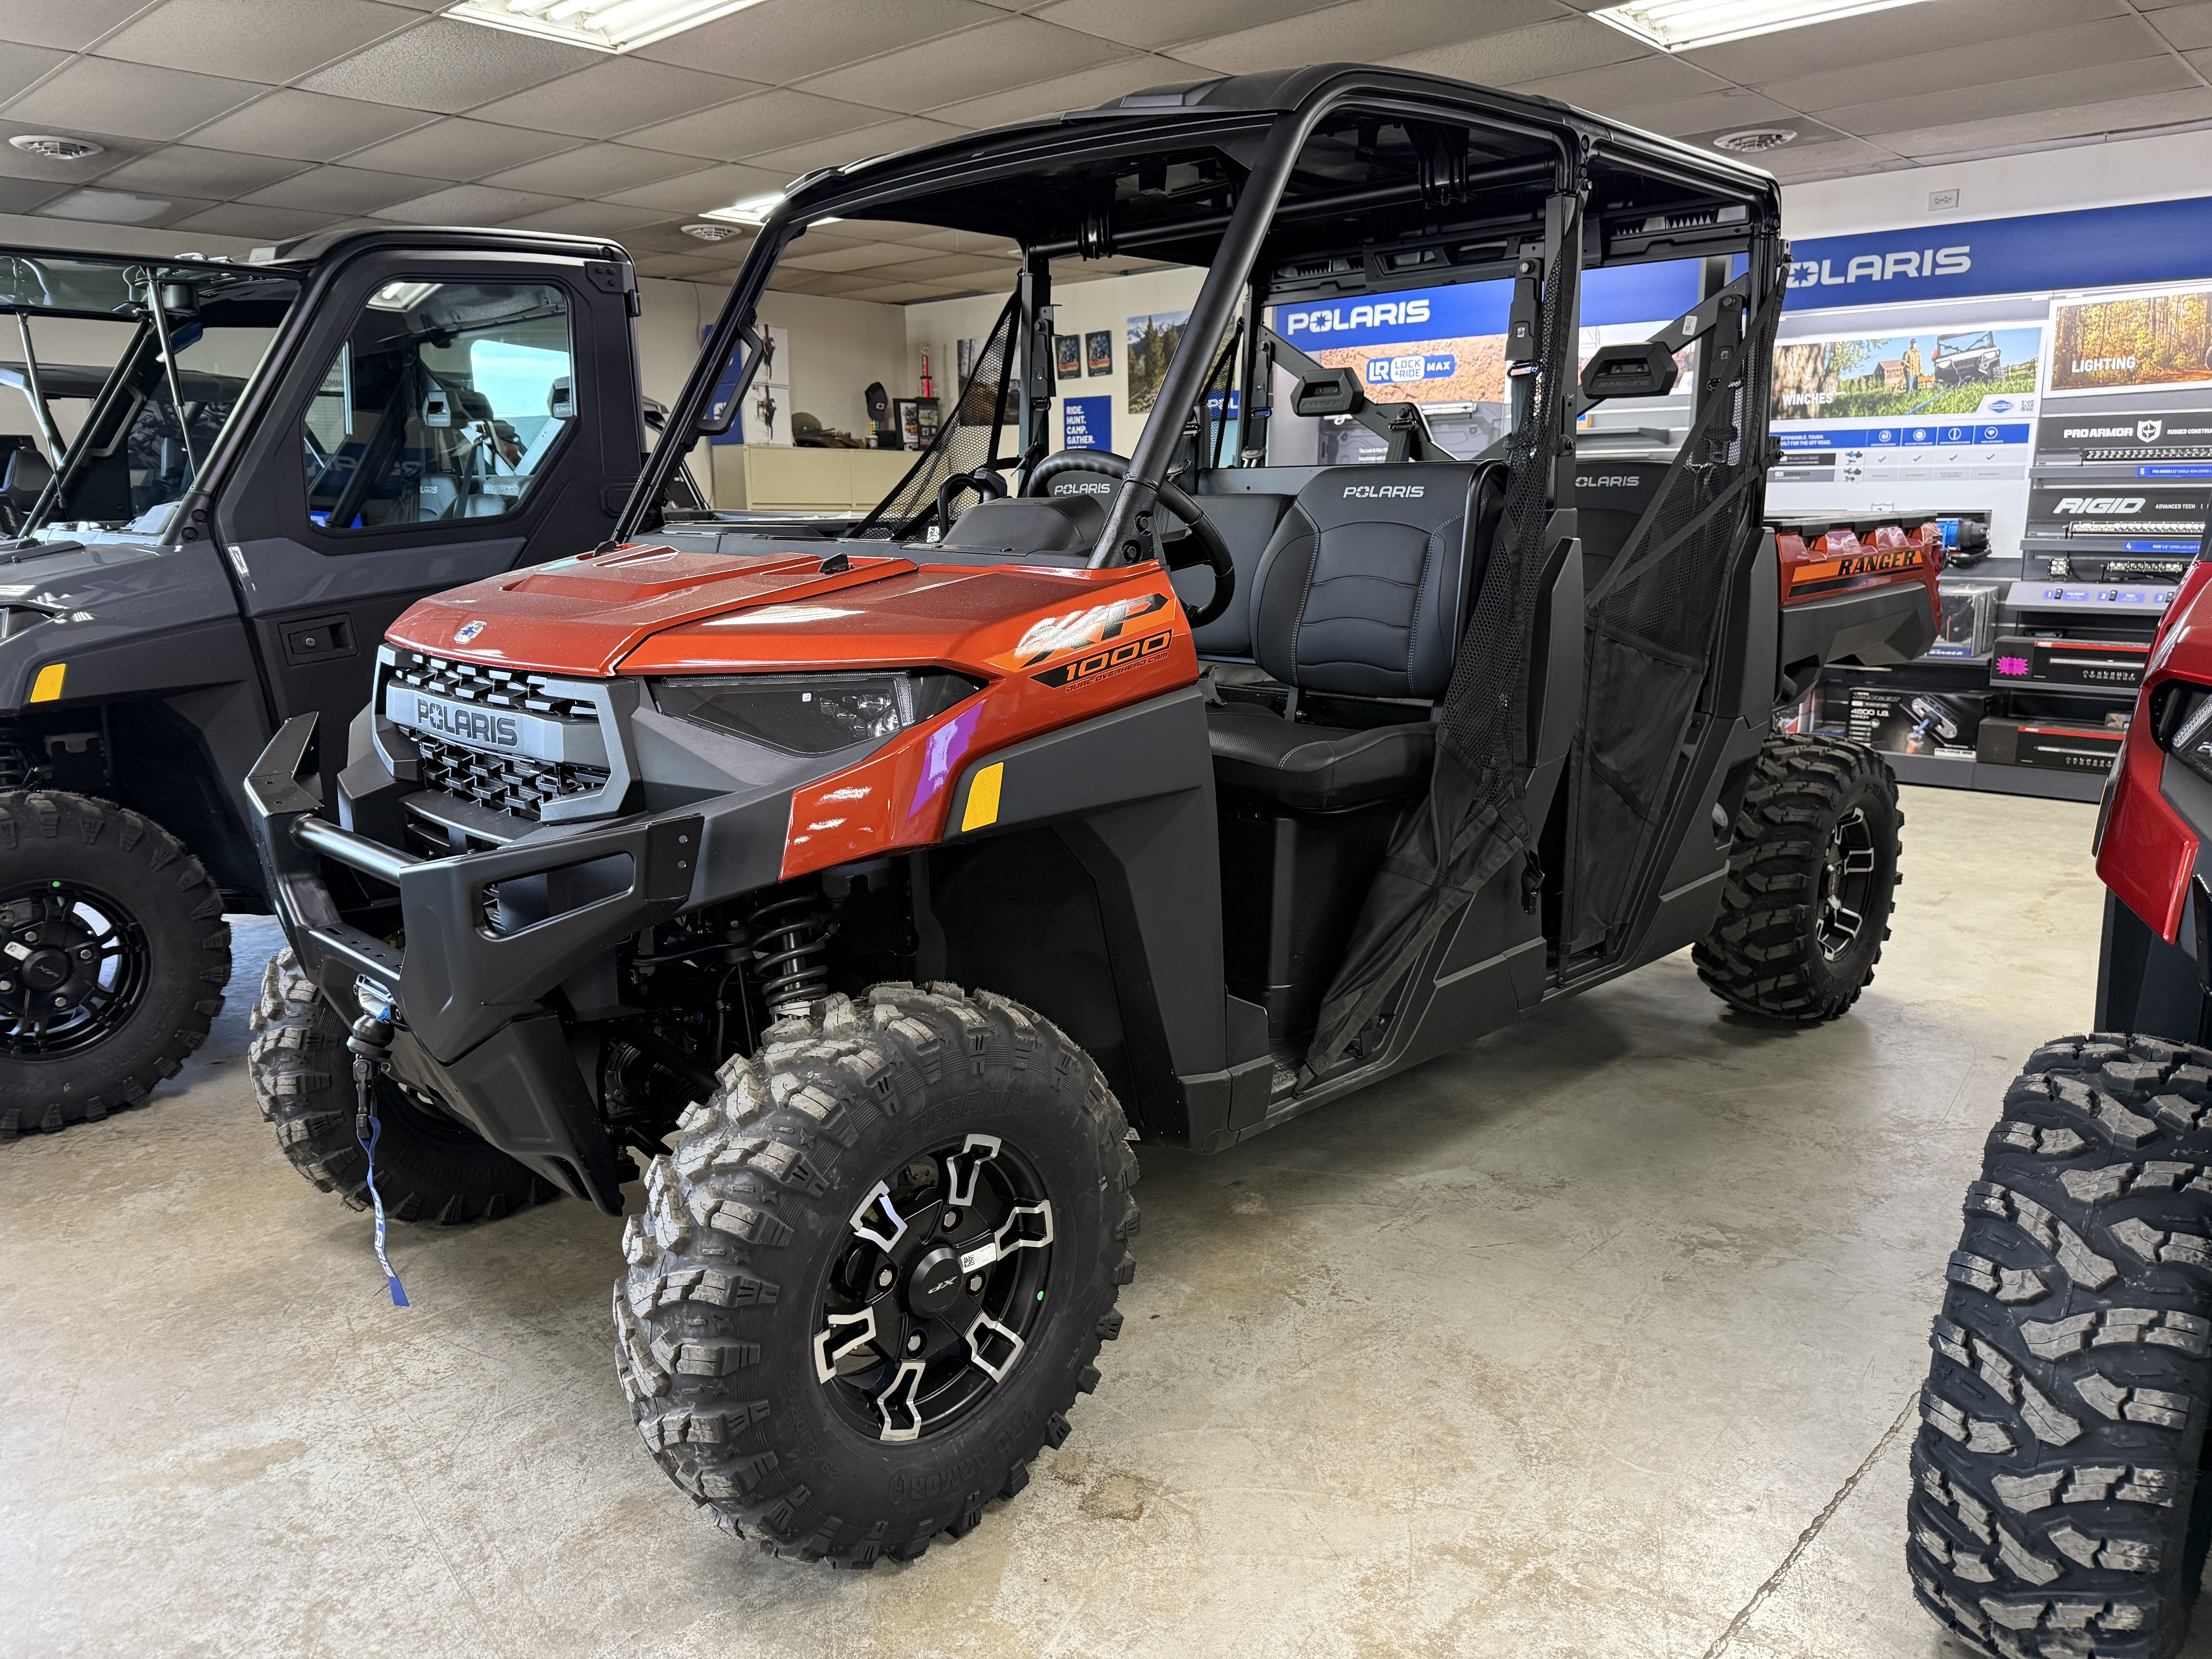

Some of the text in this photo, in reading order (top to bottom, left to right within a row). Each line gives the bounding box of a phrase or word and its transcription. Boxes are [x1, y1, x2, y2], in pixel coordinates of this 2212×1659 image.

[1776, 246, 1971, 288] OLARIS
[1288, 299, 1430, 335] POLARIS
[1395, 359, 1421, 369] LOCK
[1427, 361, 1450, 371] MAX
[2072, 356, 2136, 373] LIGHTING
[1395, 369, 1421, 378] &RIDE
[1782, 392, 1834, 405] WINCHES
[1066, 405, 1084, 415] RIDE.
[1066, 416, 1086, 424] HUNT.
[1066, 426, 1088, 434] CAMP.
[1067, 435, 1095, 445] GATHER.
[1575, 476, 1640, 487] OLARIS
[1054, 483, 1110, 495] POLARIS
[1343, 486, 1424, 498] POLARIS
[2053, 498, 2146, 514] RIGID
[1838, 550, 1916, 576] RANGER
[1067, 632, 1171, 681] 1000
[1066, 652, 1168, 692] DUAL OVERHEAD CAM
[417, 698, 517, 748] POLARIS
[370, 1187, 395, 1278] POLARIS
